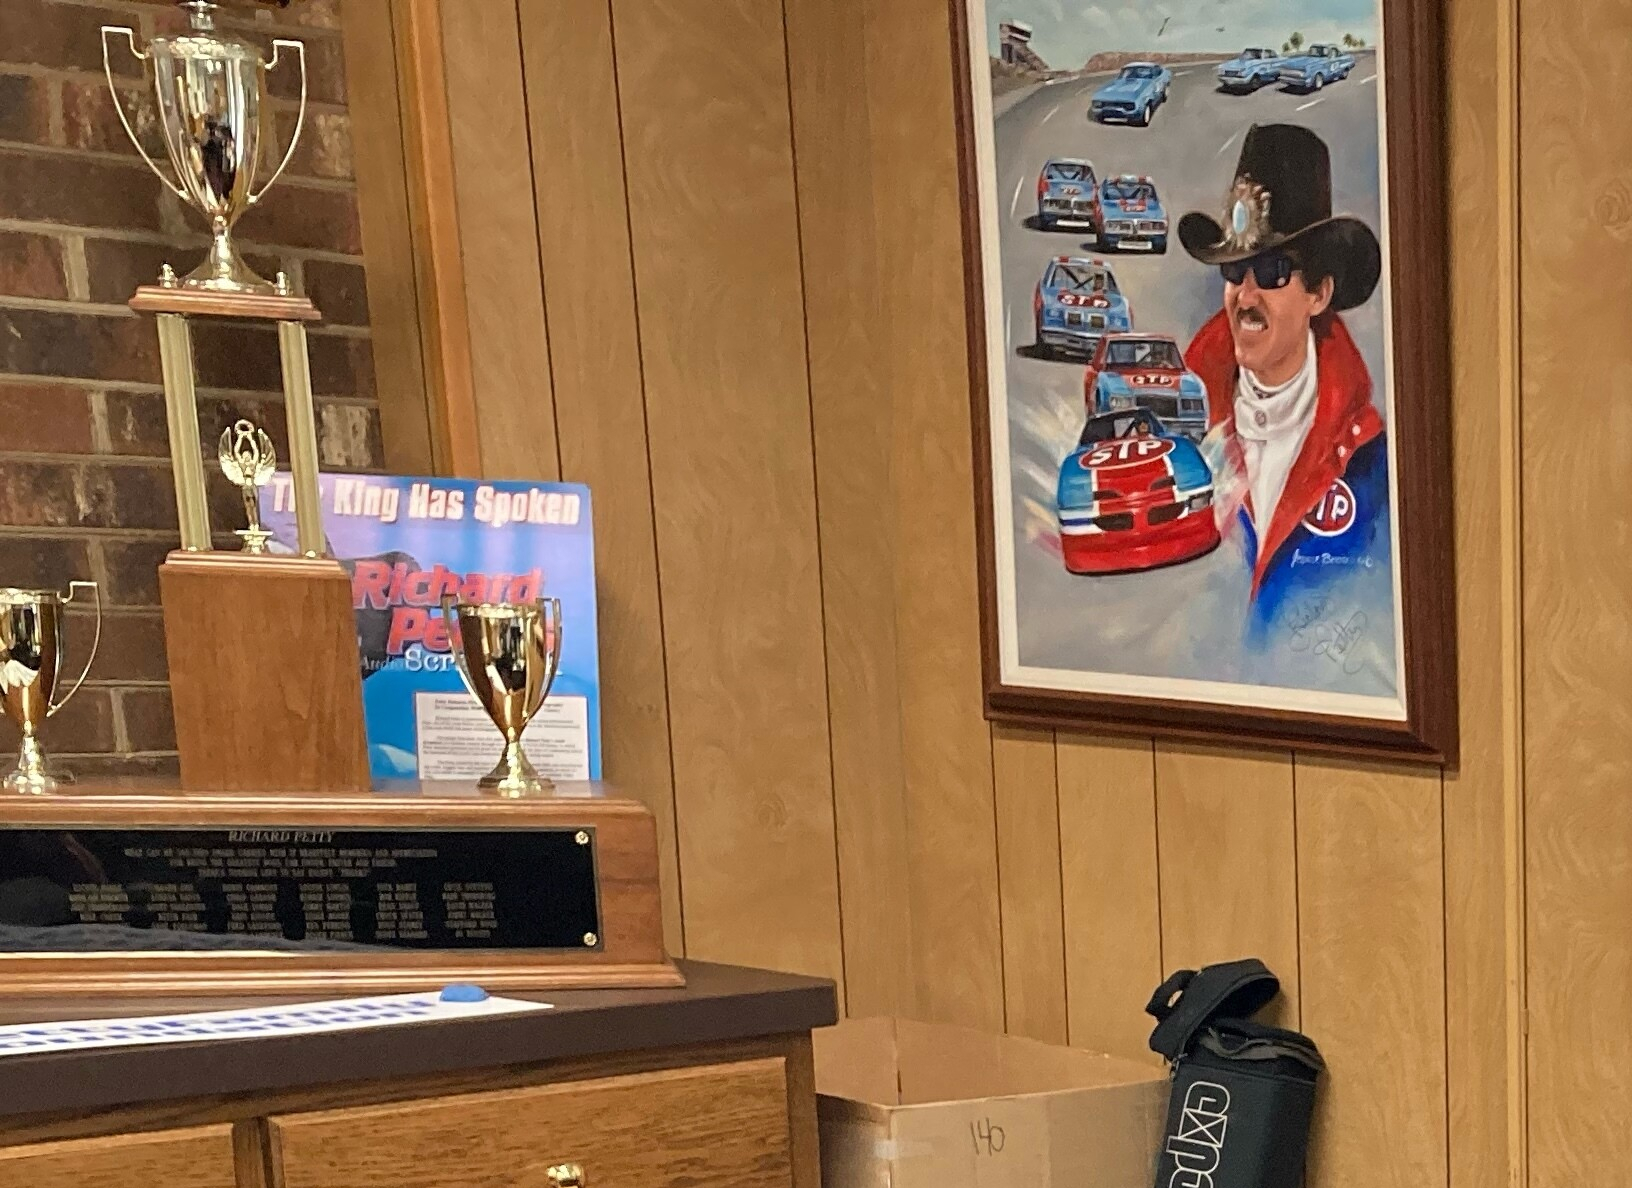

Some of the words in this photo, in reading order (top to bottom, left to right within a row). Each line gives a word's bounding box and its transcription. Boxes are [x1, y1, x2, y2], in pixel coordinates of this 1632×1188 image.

[1088, 440, 1162, 465] STP
[333, 478, 399, 522] King
[408, 483, 464, 519] Has
[473, 486, 580, 527] Spoken
[1315, 484, 1349, 522] TP
[351, 559, 545, 611] Richard
[970, 1117, 1006, 1157] 140
